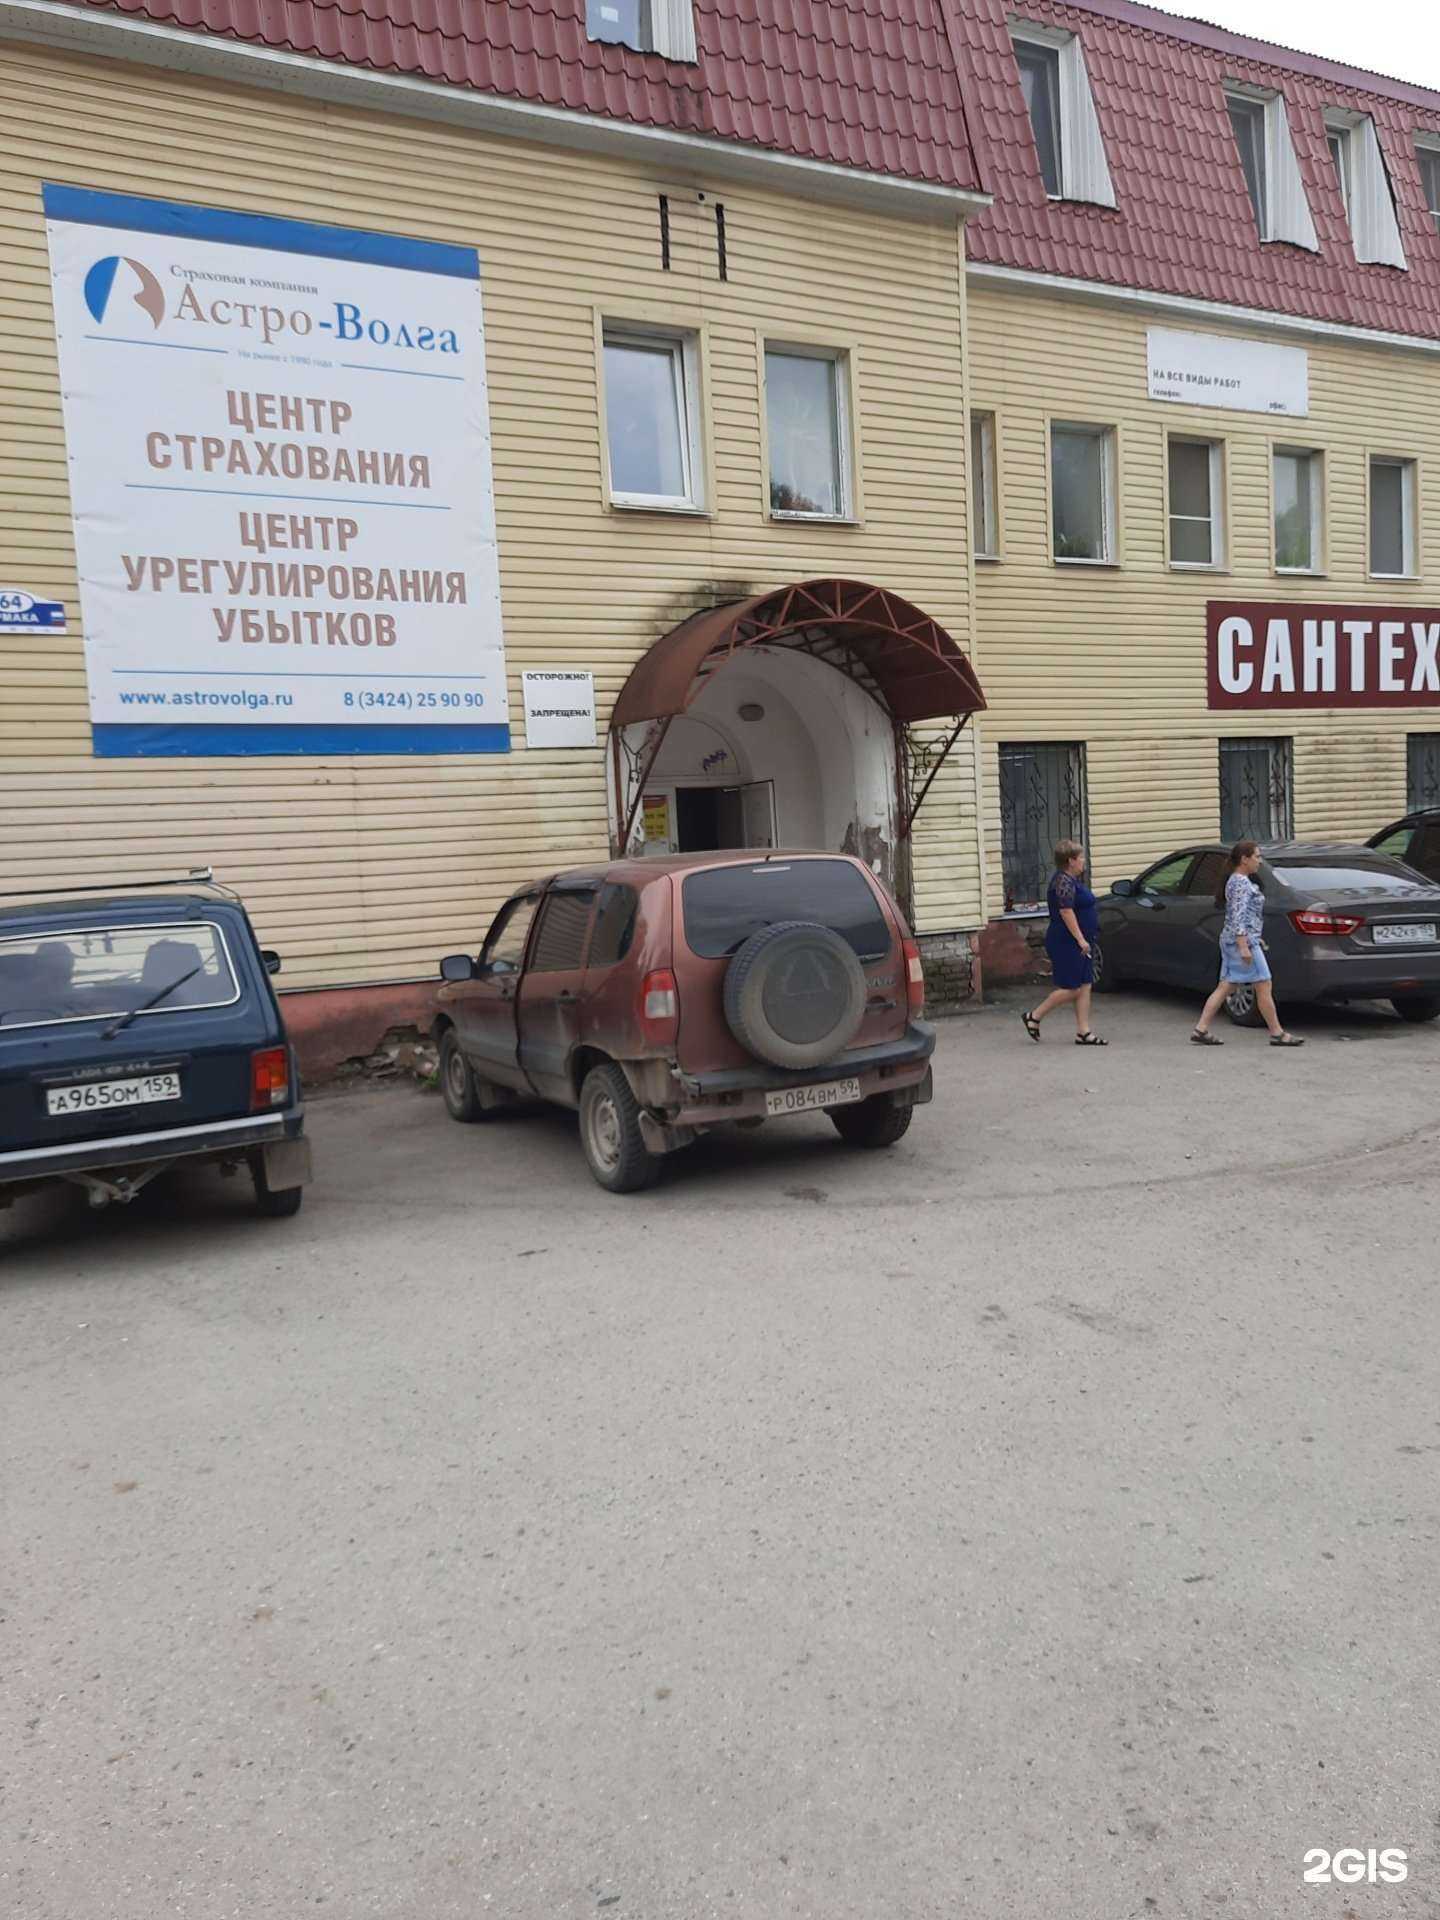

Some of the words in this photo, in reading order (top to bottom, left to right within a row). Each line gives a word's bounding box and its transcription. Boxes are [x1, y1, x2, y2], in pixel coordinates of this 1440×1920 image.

[170, 264, 246, 283] Страховая
[249, 277, 318, 296] компания
[173, 282, 461, 354] Астро-Волга
[1153, 369, 1165, 379] НА
[1167, 371, 1183, 382] ВСЕ
[1185, 373, 1212, 386] ВИДЫ
[1213, 376, 1241, 389] РАБОТ
[226, 389, 352, 434] ЦЕНТР
[146, 431, 431, 489] СТРАХОВАНИЯ
[239, 511, 359, 554] ЦЕНТР
[121, 555, 467, 604] УРЕГУЛИРОВАНИЯ
[0, 595, 21, 609] 64
[212, 608, 397, 647] УБЫТКОВ
[1218, 616, 1440, 693] САНТЕХ
[526, 673, 589, 681] ОСТОРОЖНО!
[119, 690, 293, 710] www.astrovolga.ru
[344, 692, 354, 706] 8
[358, 690, 413, 711] (3424)
[416, 692, 437, 707] 25
[440, 692, 460, 707] 90
[464, 693, 484, 707] 90
[530, 709, 591, 718] ЗАПРЕЩЕНА!
[144, 1076, 173, 1092] 159
[840, 1079, 854, 1094] 59
